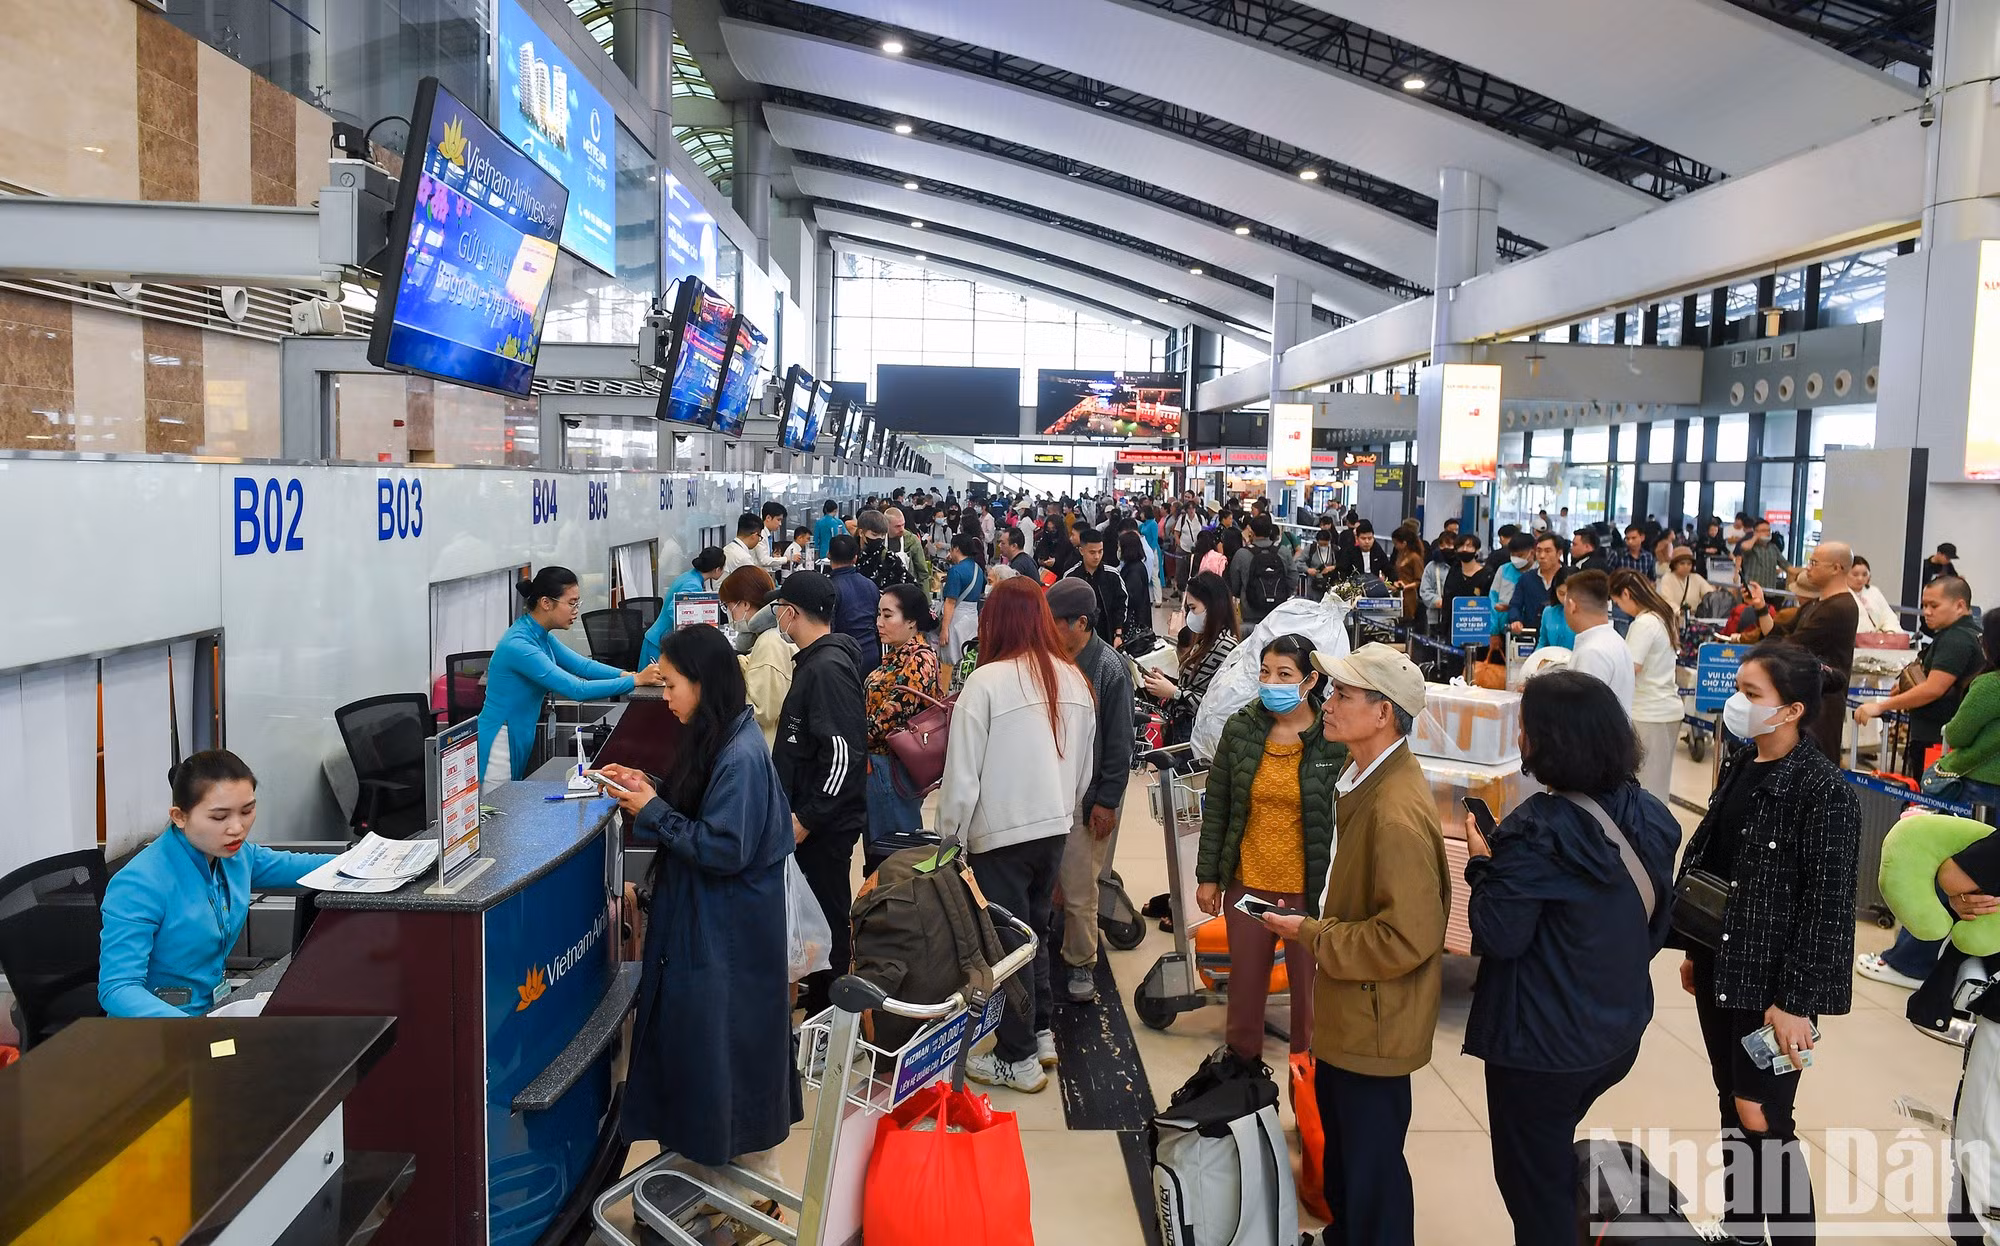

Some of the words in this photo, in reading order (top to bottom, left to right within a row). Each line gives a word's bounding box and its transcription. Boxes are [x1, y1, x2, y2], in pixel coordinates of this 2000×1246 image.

[435, 260, 483, 311] Baggage
[378, 477, 423, 541] B03
[533, 479, 557, 525] B04
[589, 481, 608, 520] B05
[660, 478, 674, 511] B06
[687, 479, 698, 507] B07
[234, 477, 304, 556] B02
[1701, 679, 1719, 687] CHỜ
[1721, 680, 1733, 688] TẠI
[1707, 671, 1720, 679] VUI
[1904, 791, 1949, 811] INTERNATIONAL
